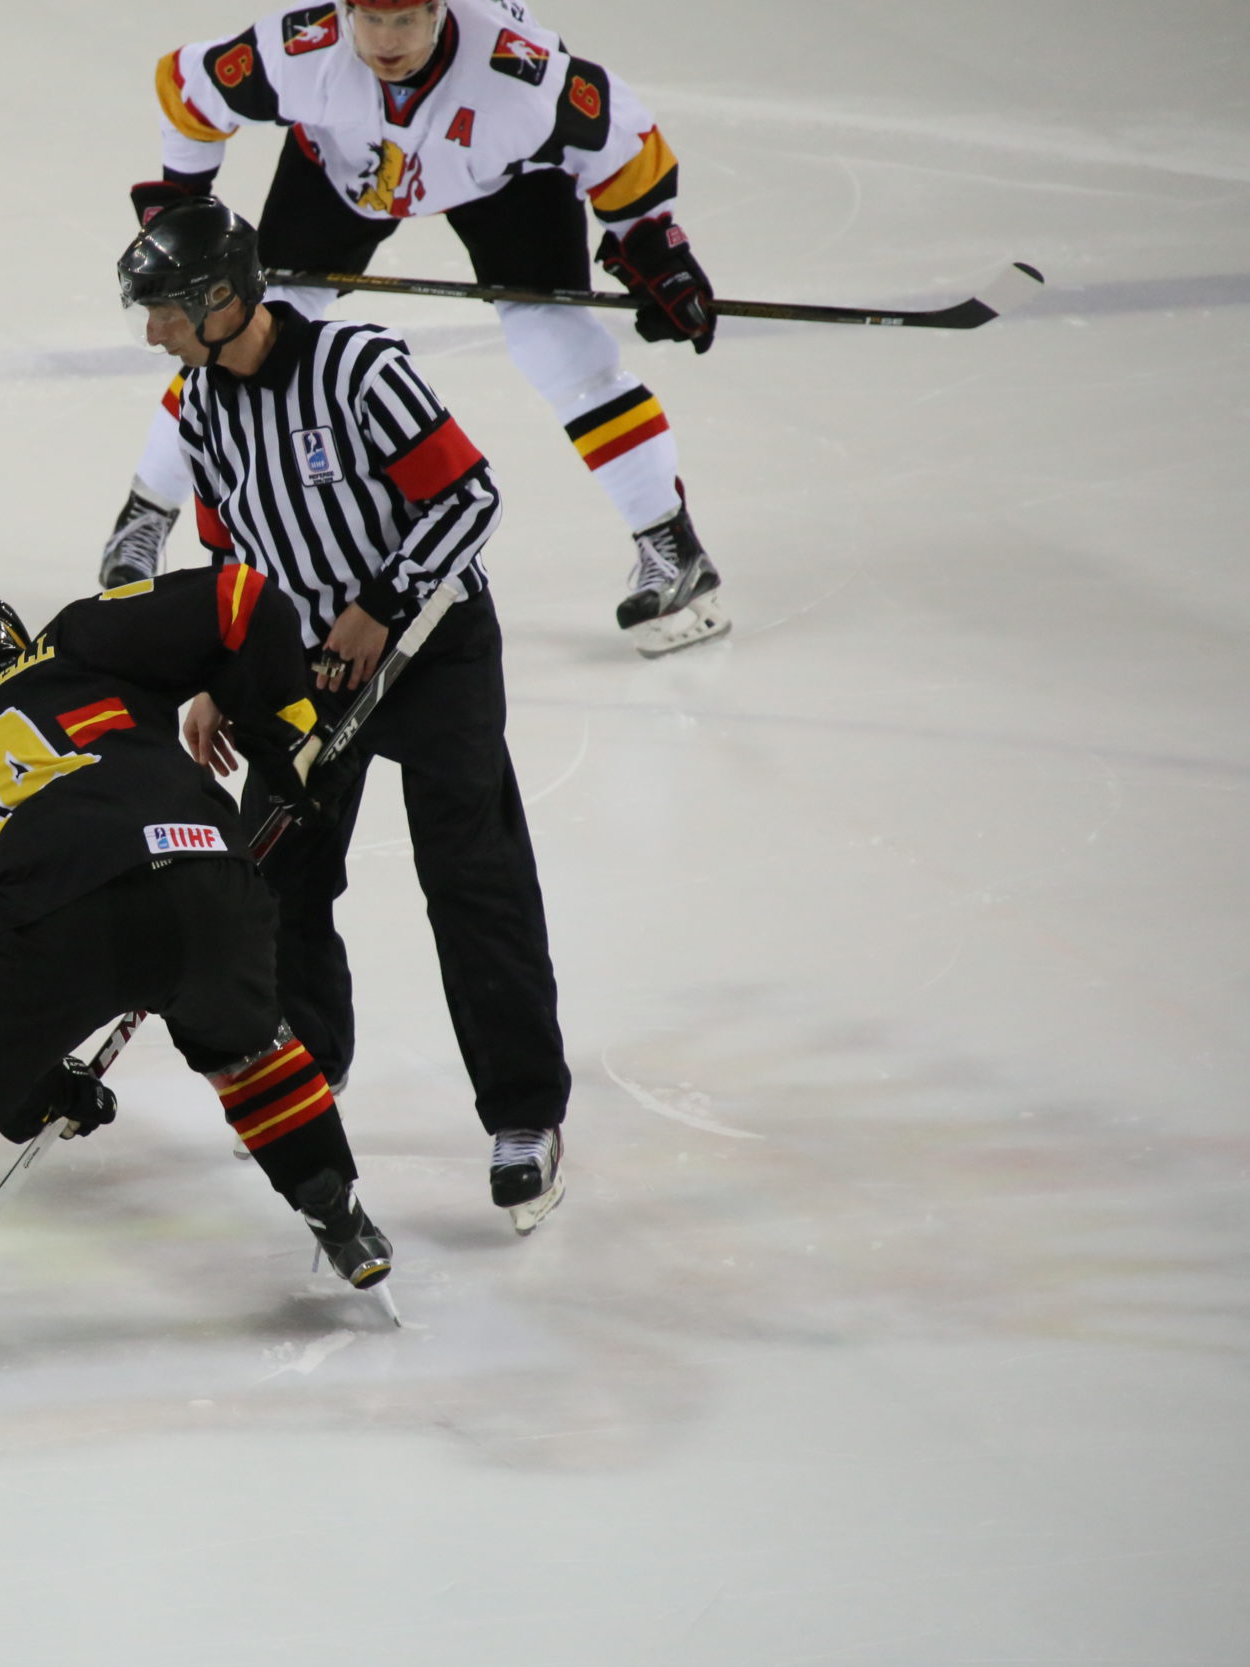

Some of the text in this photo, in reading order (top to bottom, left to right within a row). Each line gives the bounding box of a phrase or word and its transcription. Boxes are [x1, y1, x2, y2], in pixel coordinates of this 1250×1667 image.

[215, 43, 253, 88] 6
[569, 75, 601, 119] 6
[445, 107, 475, 148] A
[169, 827, 216, 849] IIHF
